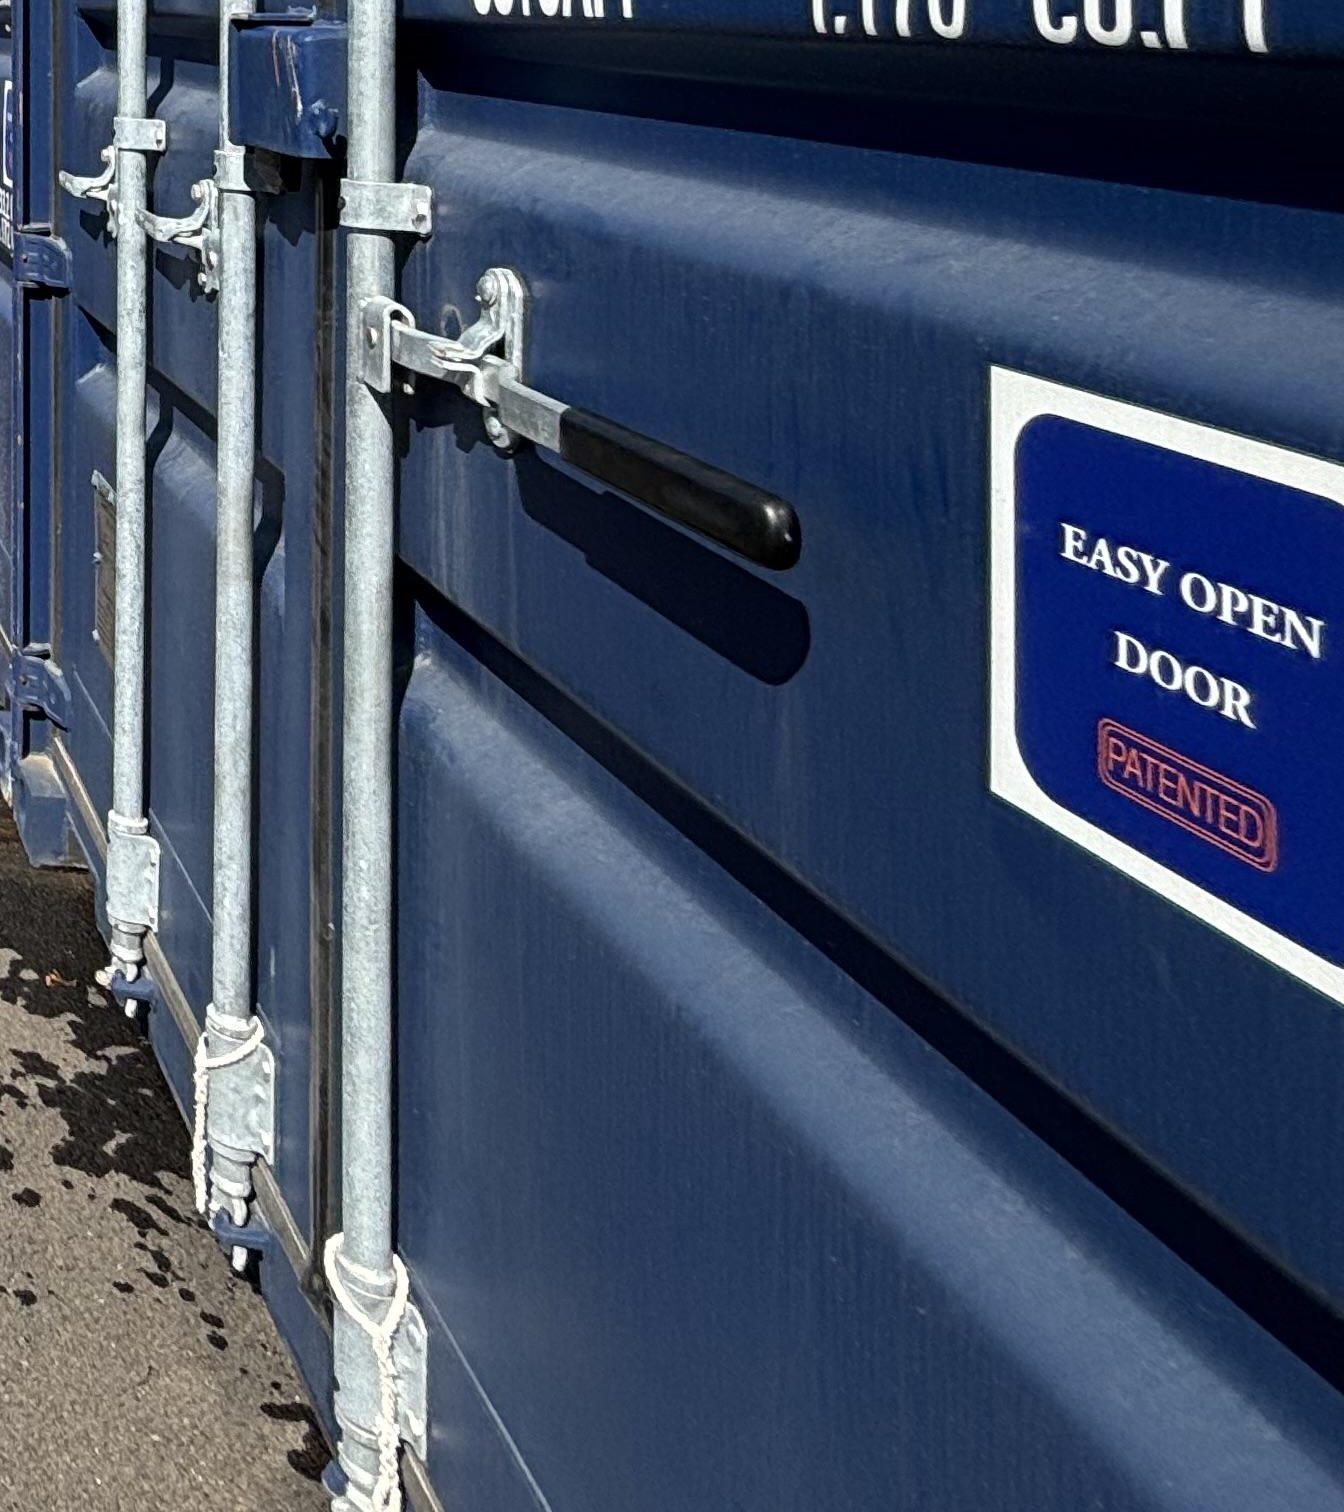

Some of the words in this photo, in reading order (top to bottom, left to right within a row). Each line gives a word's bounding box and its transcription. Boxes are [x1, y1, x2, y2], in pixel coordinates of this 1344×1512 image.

[1059, 522, 1170, 596] EASY
[1179, 571, 1325, 659] OPEN
[1113, 630, 1257, 730] DOOR
[1107, 736, 1265, 849] PATENTED
